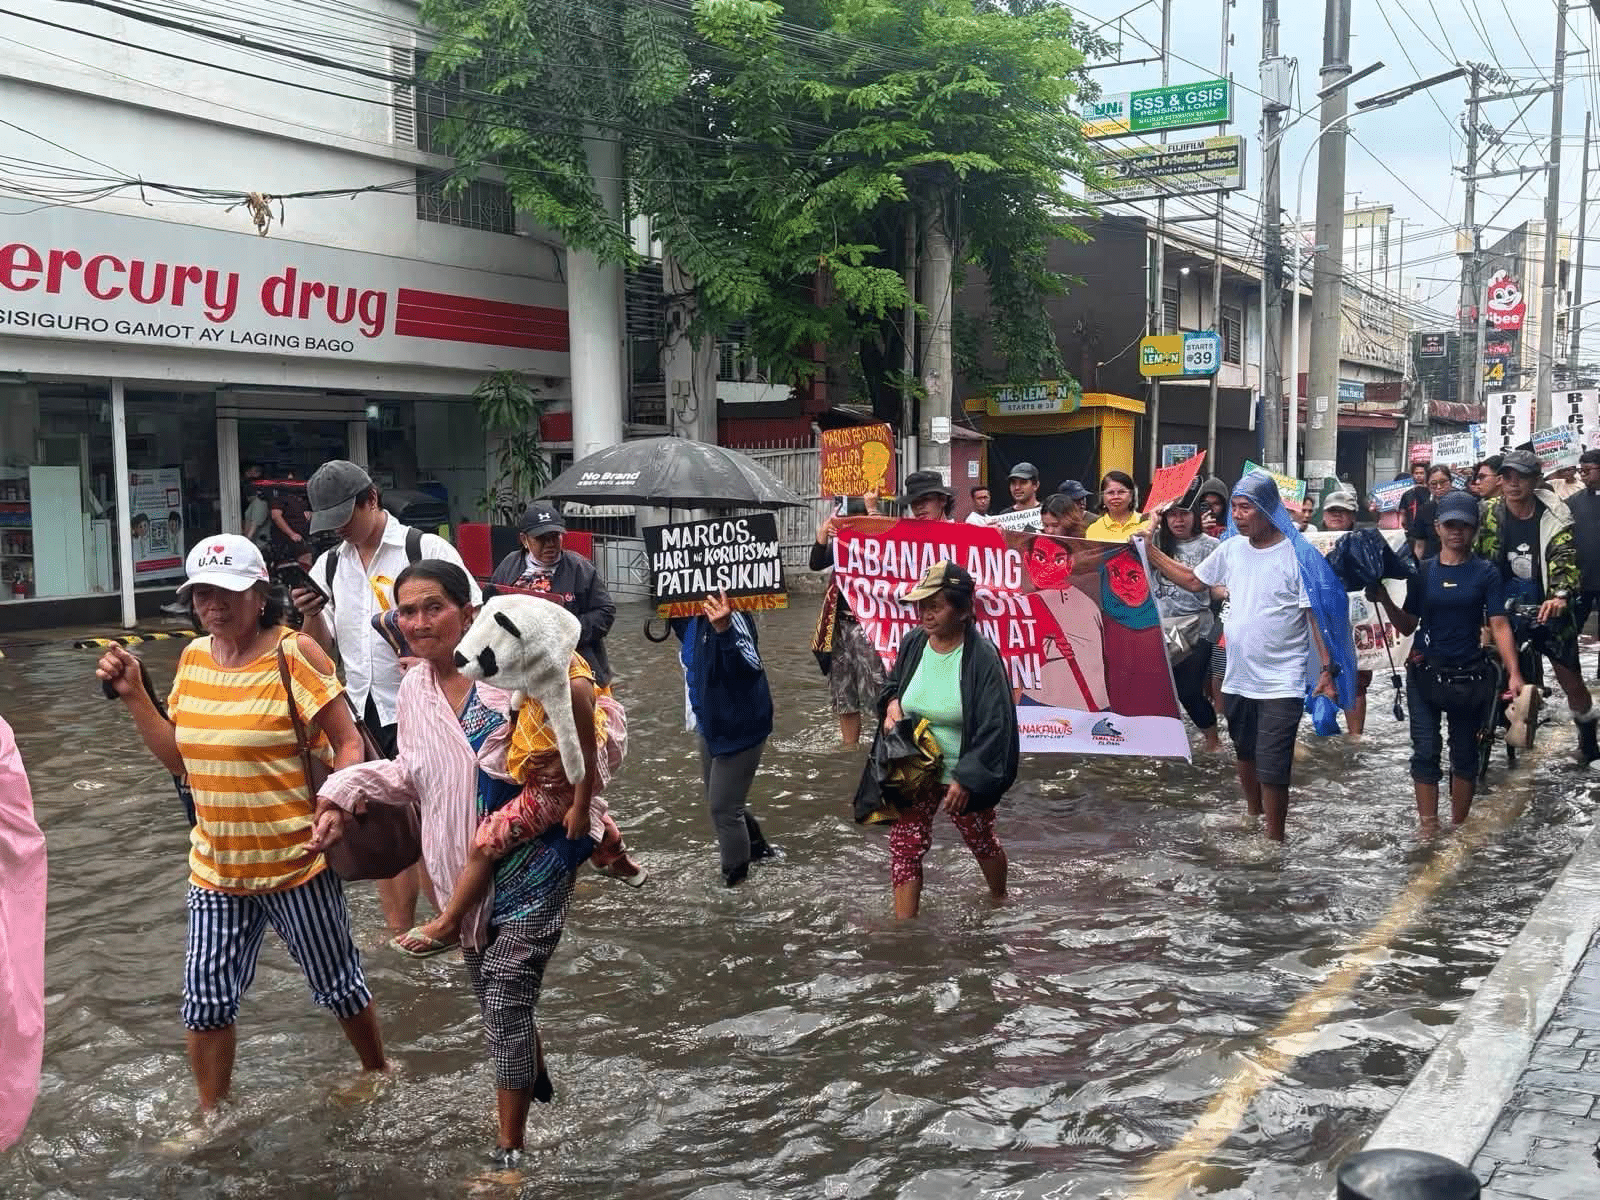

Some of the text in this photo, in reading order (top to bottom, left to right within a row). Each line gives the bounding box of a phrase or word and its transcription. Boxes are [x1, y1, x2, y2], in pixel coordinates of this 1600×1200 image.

[1133, 96, 1165, 111] SSS
[1169, 93, 1180, 106] &
[1185, 87, 1224, 104] GSIS
[1140, 101, 1217, 116] PENSION LOAN
[1162, 152, 1206, 166] Printing
[1207, 148, 1237, 161] Shop
[1167, 140, 1205, 153] FUJIFILM
[0, 243, 388, 339] ercury drug
[0, 309, 354, 352] ISIGURO GAMOT AY LAGING BAGO
[823, 429, 852, 448] MARCOS
[826, 449, 860, 468] NG LUPA
[581, 471, 640, 480] No Brand
[653, 549, 690, 572] HARI
[703, 541, 779, 566] KORUPSYON
[966, 545, 1023, 590] ANG
[657, 558, 781, 597] PATALSIKIN!
[1008, 618, 1037, 649] AT
